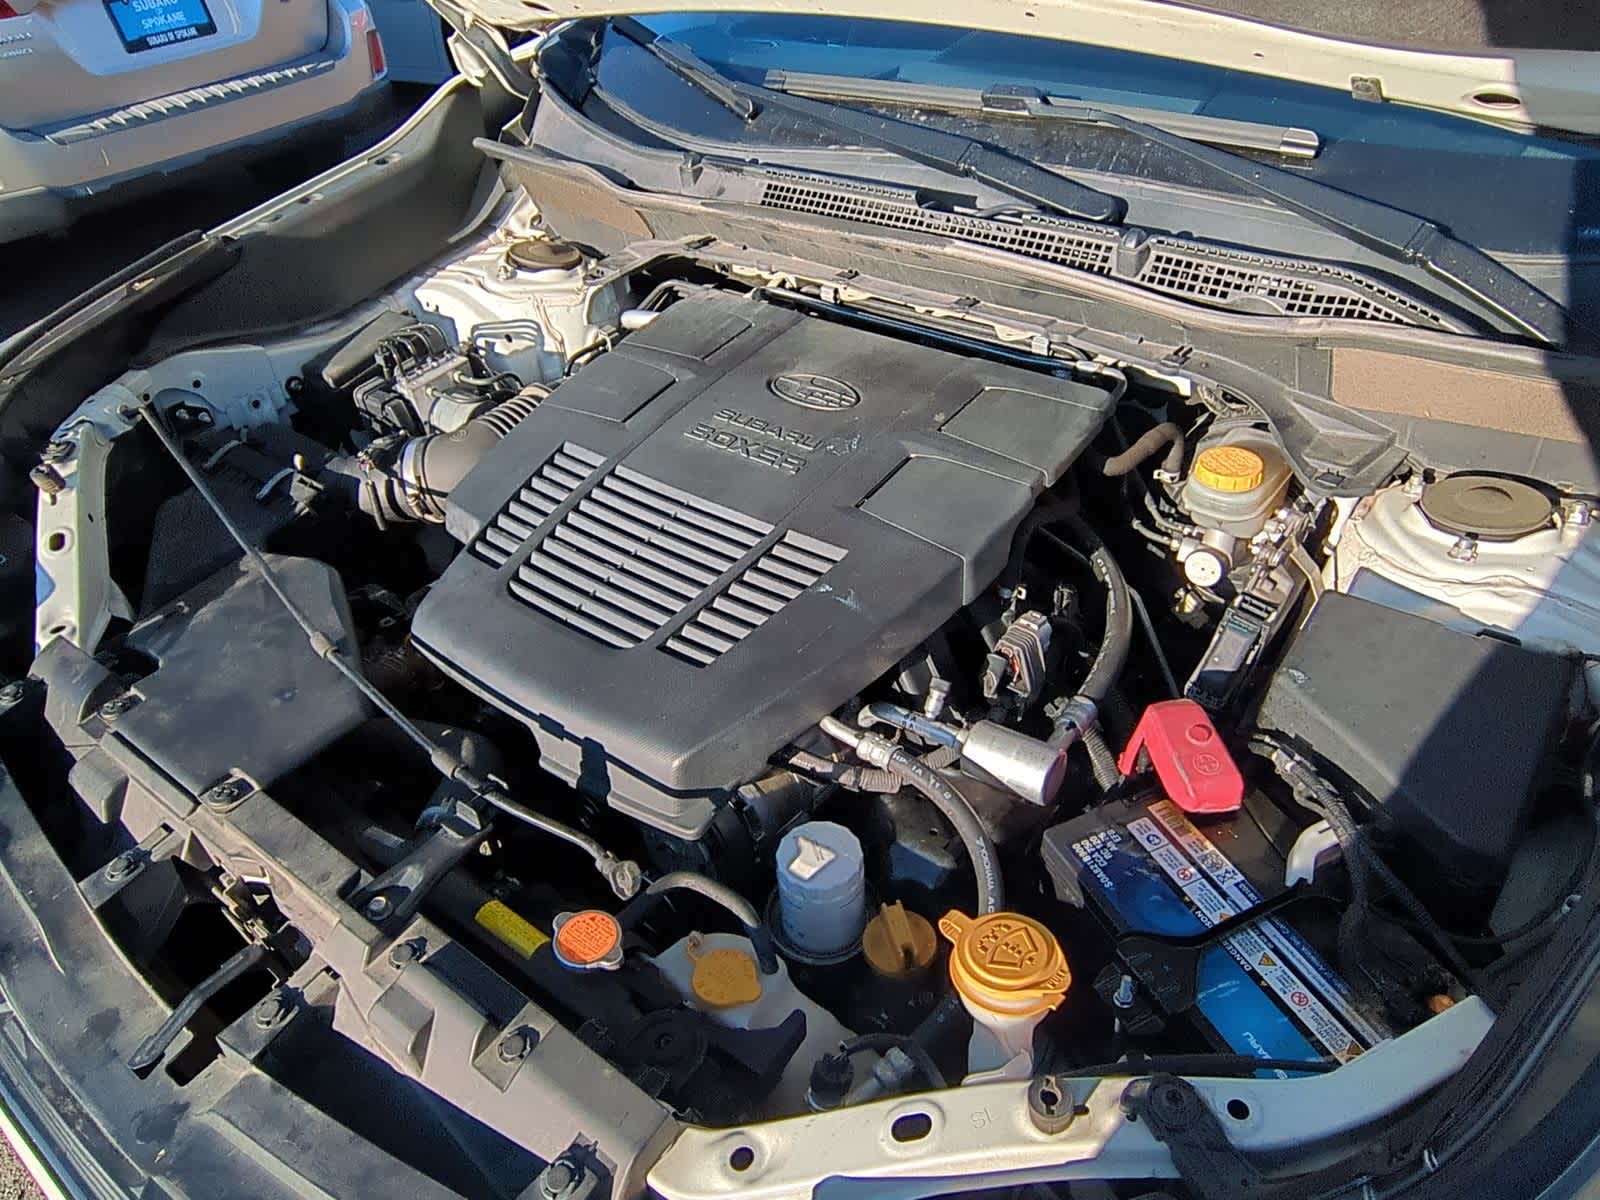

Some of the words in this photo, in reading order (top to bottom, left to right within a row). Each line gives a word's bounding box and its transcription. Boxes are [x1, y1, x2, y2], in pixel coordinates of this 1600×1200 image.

[141, 11, 187, 29] SPOKANE
[713, 408, 825, 450] SUBARU
[683, 422, 808, 475] BOXER
[1080, 837, 1095, 853] 750
[1091, 850, 1107, 868] CCA
